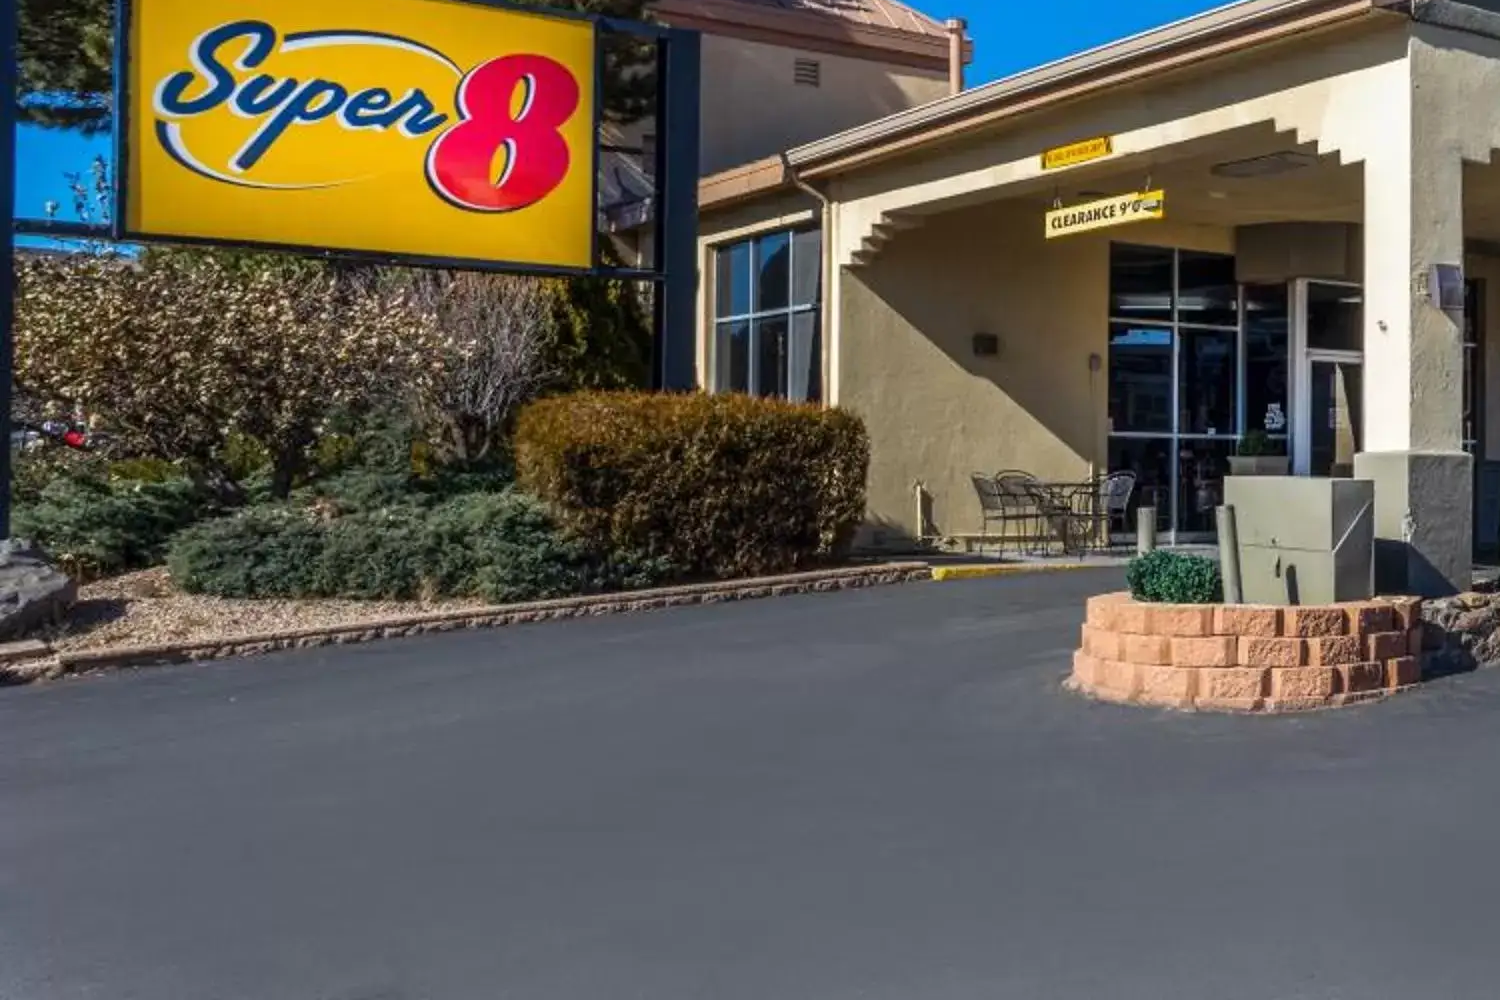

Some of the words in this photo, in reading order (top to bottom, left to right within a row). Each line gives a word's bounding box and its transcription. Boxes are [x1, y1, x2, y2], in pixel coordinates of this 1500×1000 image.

[154, 20, 449, 173] Super
[424, 53, 580, 213] 8
[1051, 204, 1117, 229] CLEARANCE
